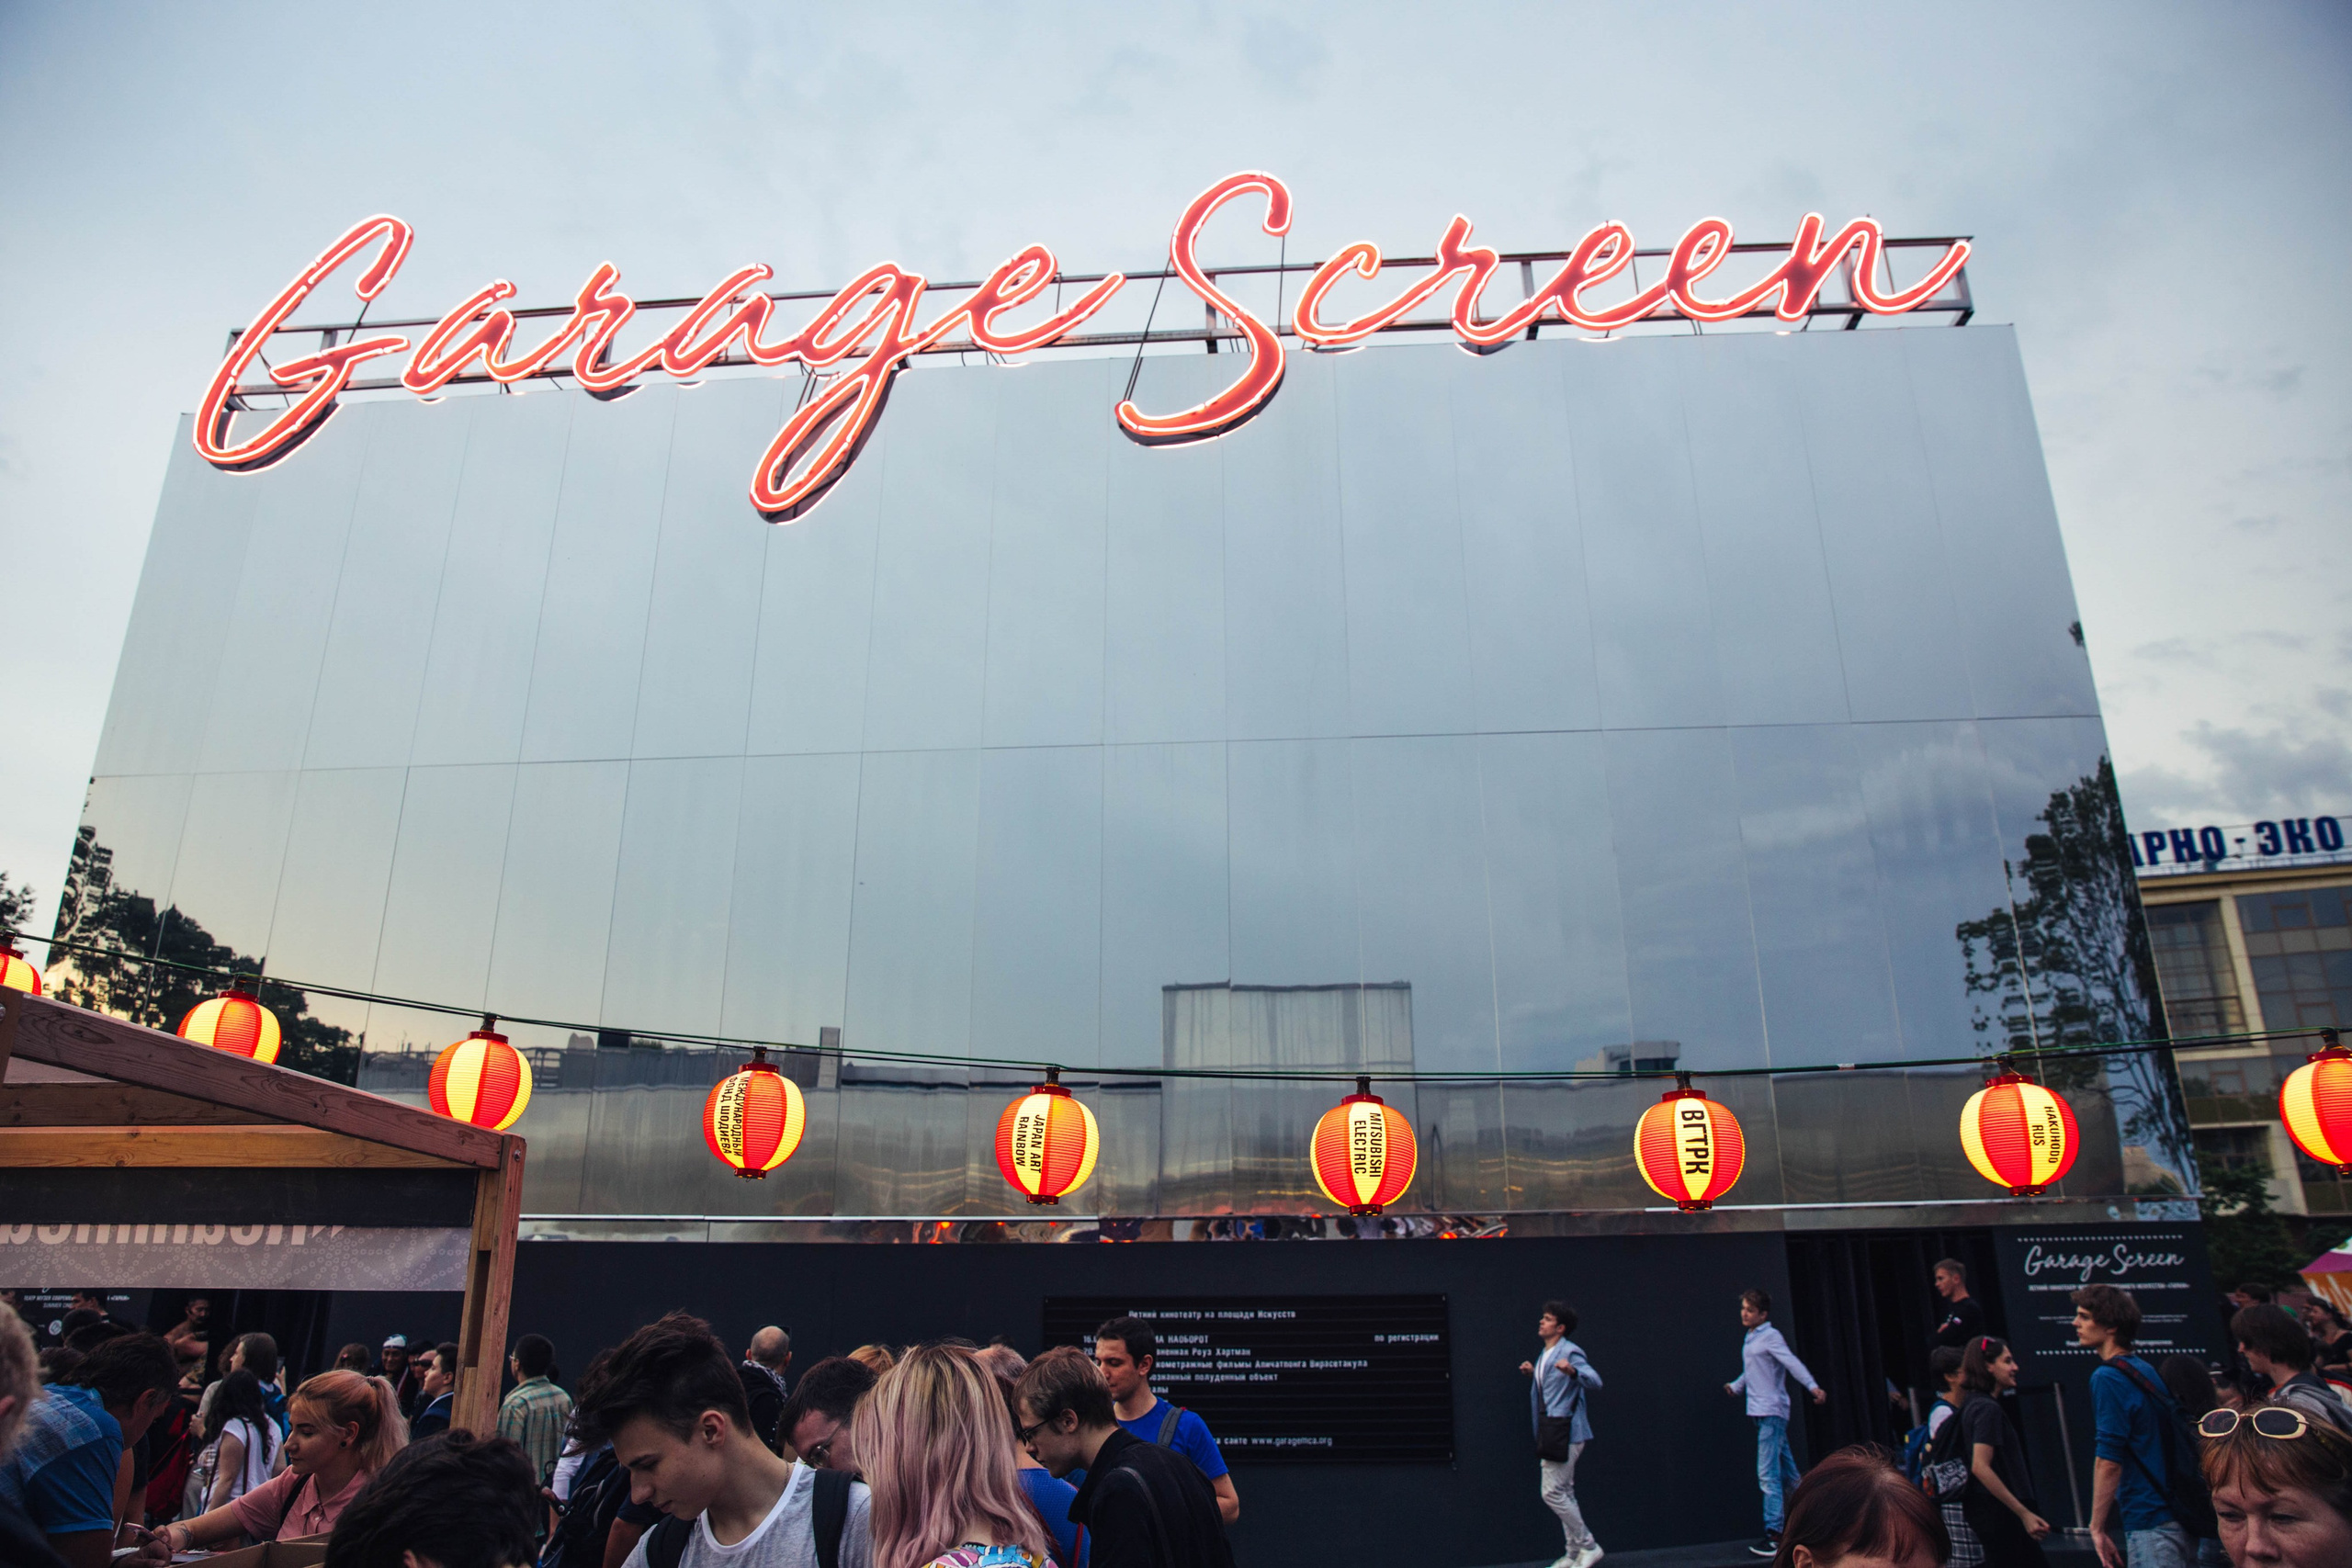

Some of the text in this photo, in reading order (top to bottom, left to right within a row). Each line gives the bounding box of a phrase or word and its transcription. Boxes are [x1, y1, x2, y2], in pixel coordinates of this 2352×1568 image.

[194, 170, 1971, 524] Garage Screen
[718, 1077, 738, 1154] ФОНД ШОДИЕВА
[730, 1076, 750, 1157] МЕЖДУНАРОДНЫЙ
[2031, 1124, 2045, 1146] RUS
[2044, 1106, 2061, 1164] HAKUHODO
[1015, 1116, 1030, 1167] RAINBOW
[1030, 1114, 1046, 1174] JAPAN ART
[1354, 1120, 1367, 1174] ELECTRIC
[1369, 1112, 1383, 1178] MITSUBISHI
[1680, 1110, 1710, 1175] ВГТРК
[2024, 1243, 2185, 1282] Garage Screen
[1159, 1311, 1201, 1321] кинотеатр
[1217, 1311, 1254, 1320] площади
[1258, 1310, 1296, 1320] Искусств
[1168, 1335, 1209, 1344] НАОБОРОТ
[1374, 1335, 1385, 1343] по
[1387, 1334, 1440, 1344] регистрации
[1149, 1372, 1278, 1382] ознанный полуденный объект
[1156, 1348, 1189, 1357] вненная
[1192, 1348, 1212, 1357] Роуз
[1216, 1348, 1251, 1357] Хартман
[1156, 1360, 1213, 1370] кометражные
[1216, 1360, 1252, 1370] фильмы
[1224, 1437, 1248, 1445] сайте
[1251, 1437, 1333, 1447] www.garagemca.org
